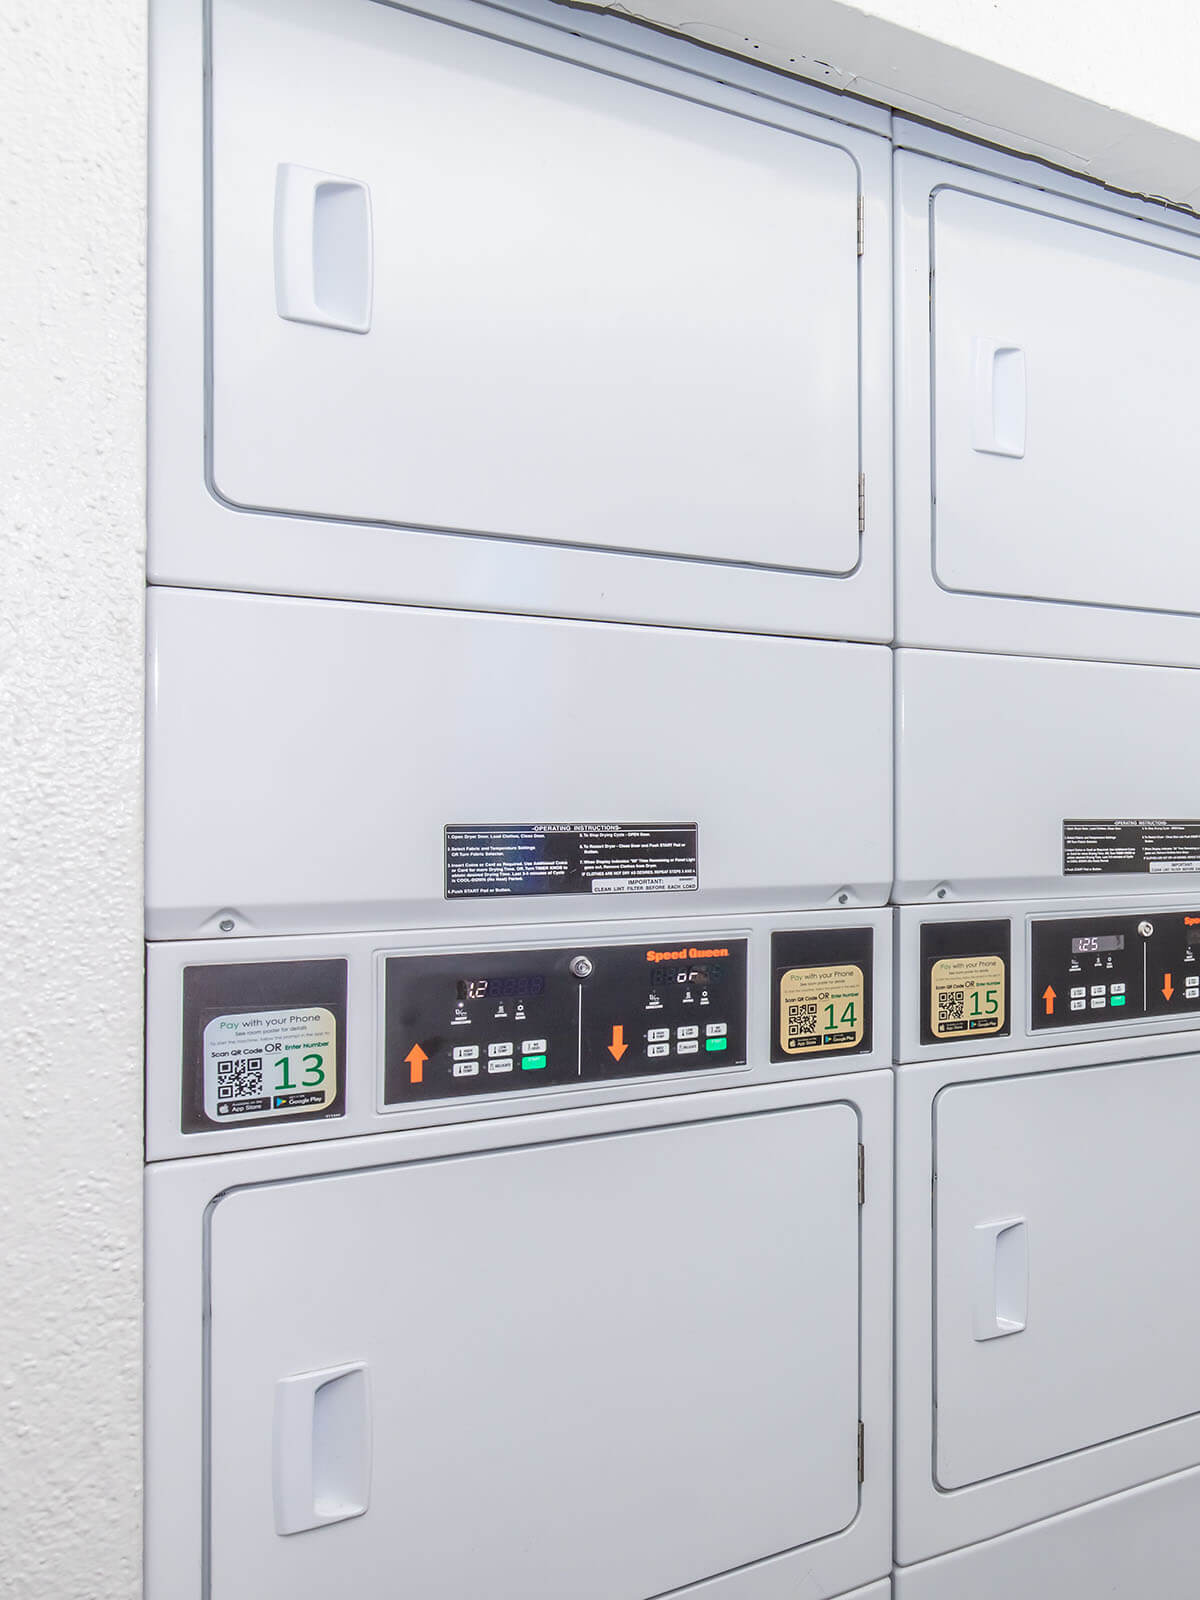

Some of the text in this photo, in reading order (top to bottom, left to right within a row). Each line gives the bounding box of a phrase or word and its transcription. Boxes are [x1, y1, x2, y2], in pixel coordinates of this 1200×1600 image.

[647, 947, 728, 963] Speed Queen
[965, 980, 975, 988] OR
[818, 992, 830, 1000] OR
[970, 990, 999, 1016] 15
[220, 1014, 320, 1030] Pay with your Phone
[824, 1002, 857, 1030] 14
[264, 1043, 282, 1052] OR
[303, 1041, 329, 1049] Number
[274, 1053, 326, 1090] 13
